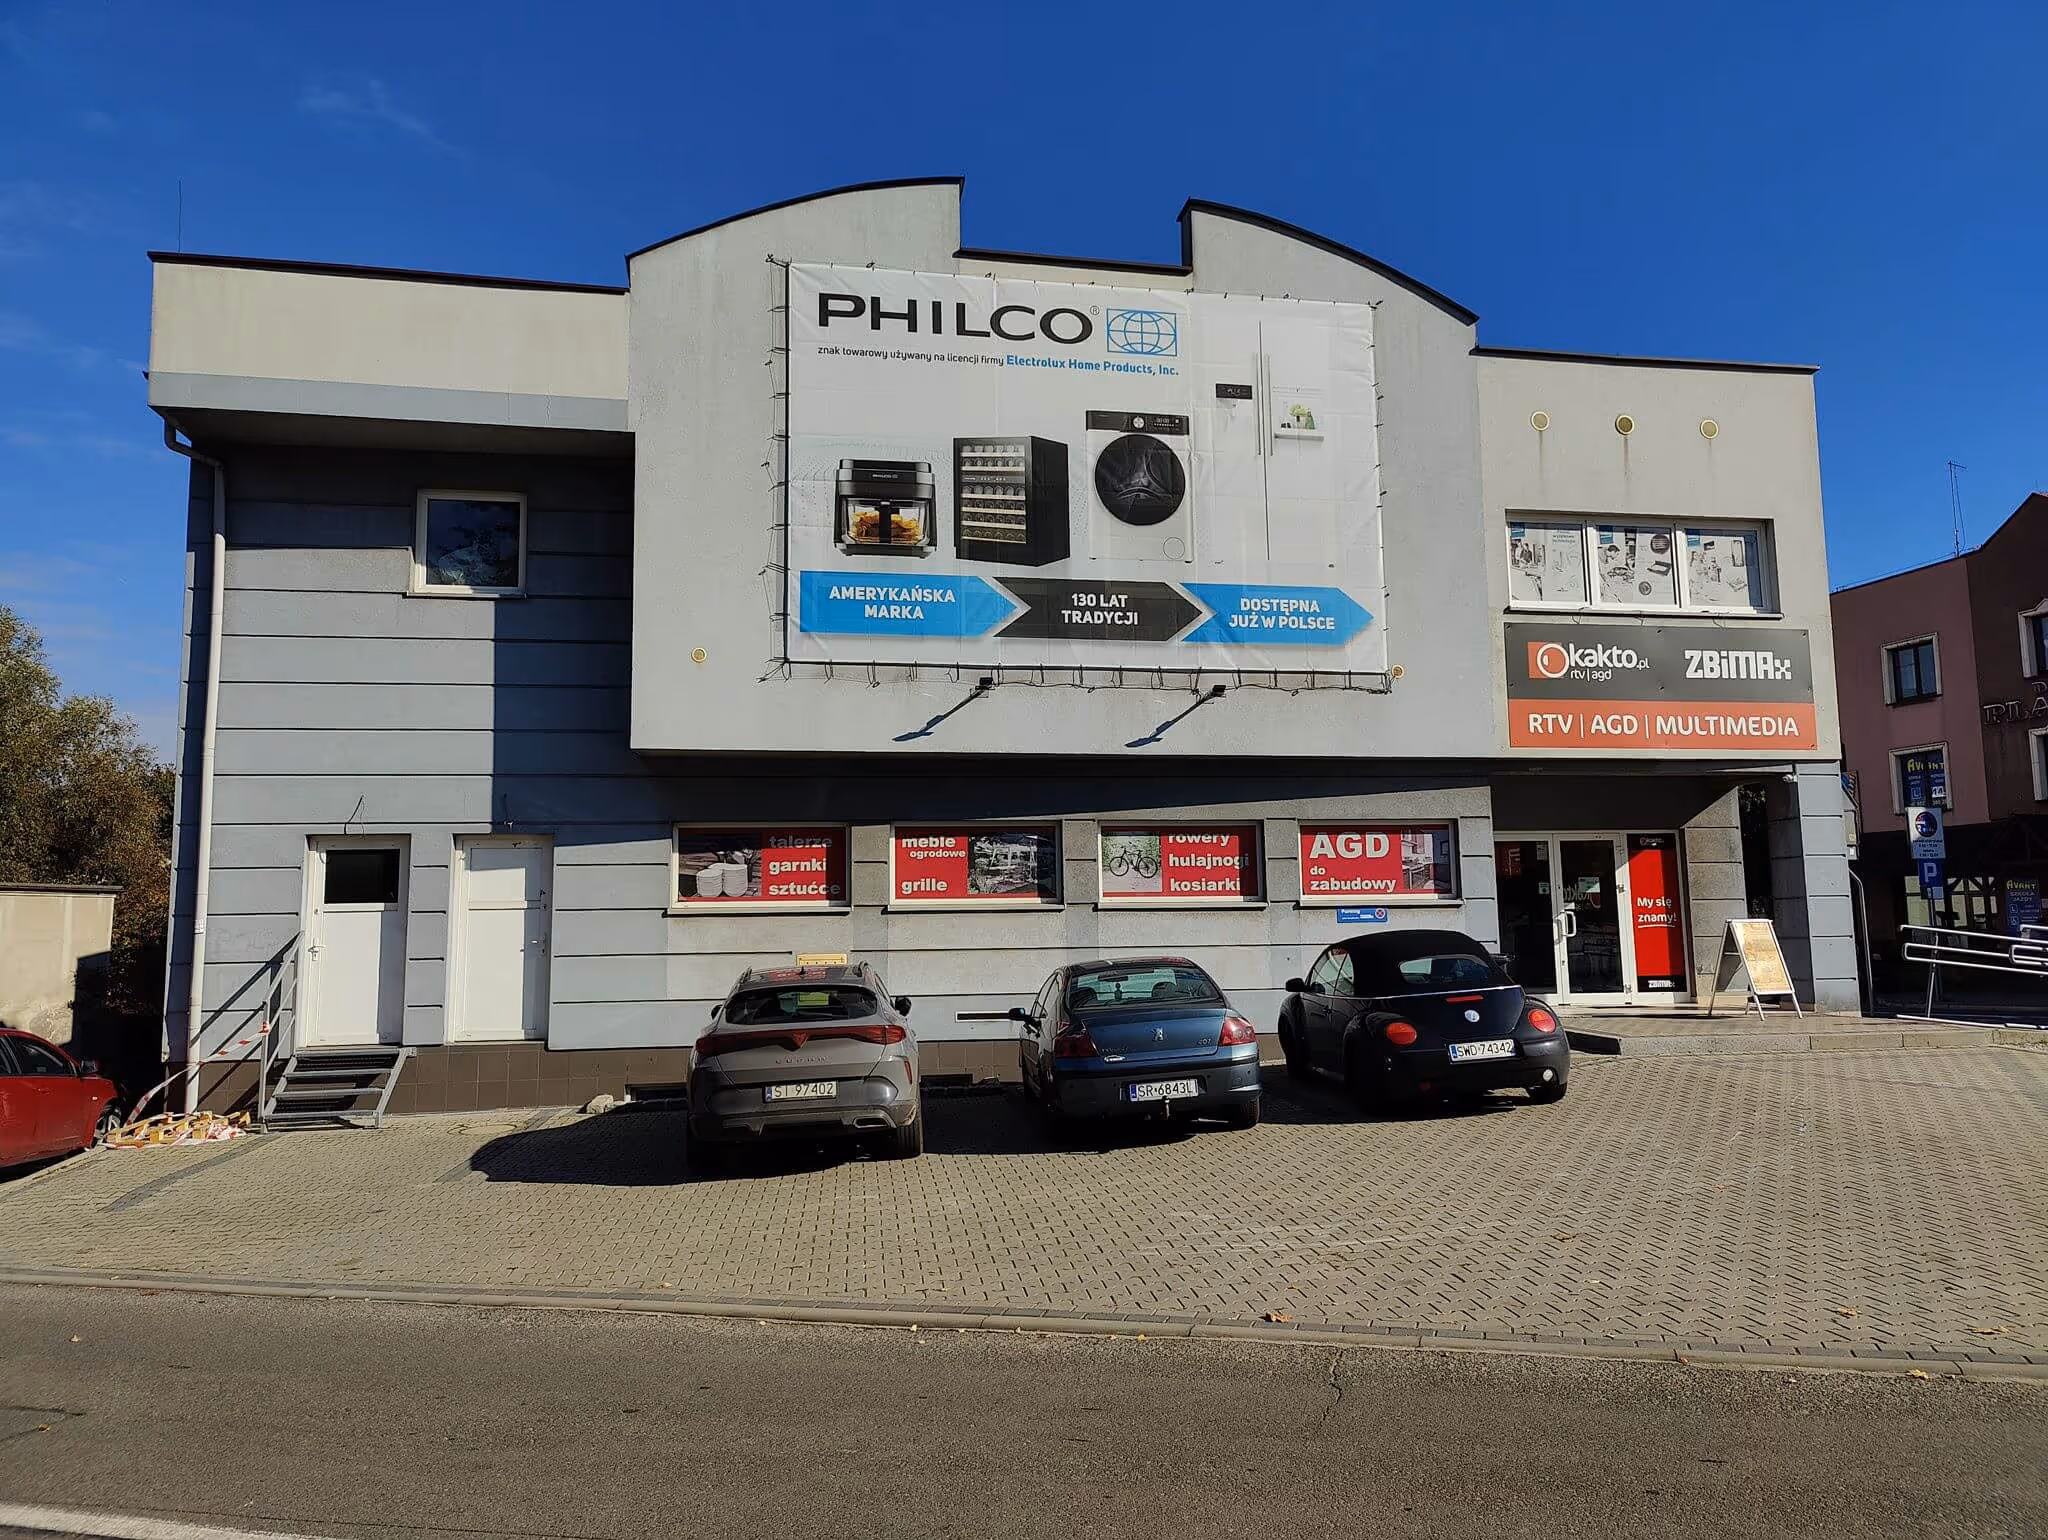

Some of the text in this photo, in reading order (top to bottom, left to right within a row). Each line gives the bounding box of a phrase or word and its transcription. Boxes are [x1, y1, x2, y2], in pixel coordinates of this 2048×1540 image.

[817, 346, 840, 355] znak
[842, 348, 888, 359] towarowy
[890, 350, 932, 362] używany
[947, 353, 979, 364] licencji
[981, 355, 1004, 366] firmy
[1006, 355, 1065, 369] Electrolux
[1068, 359, 1100, 371] Home
[1103, 361, 1155, 376] Products,
[1159, 364, 1179, 376] Inc.
[829, 584, 955, 603] AMERYKAŃSKA
[1071, 593, 1128, 608] 130 LAT
[864, 604, 924, 620] MARKA
[1240, 598, 1320, 616] DOSTĘPNA
[1061, 609, 1139, 626] TRADYCJI
[1229, 612, 1336, 631] JUŻ W POLSCE
[1528, 713, 1800, 738] RTV AGD MULTIMEDIA
[769, 836, 832, 848] talerze
[901, 836, 955, 848] meble
[1168, 833, 1230, 847] rowery
[1309, 832, 1390, 859] AGD
[909, 849, 967, 860] ogrodowe
[1168, 853, 1249, 870] hulajnogi
[769, 858, 827, 875] garnki
[1309, 866, 1326, 875] do
[768, 881, 841, 896] sztućce
[901, 878, 948, 895] grille
[1170, 877, 1240, 892] kosiarki
[1310, 877, 1396, 893] zabudowy
[1637, 896, 1672, 908] My się
[1638, 912, 1677, 923] znamy!
[1457, 1042, 1513, 1057] SWD 74342
[795, 1083, 834, 1096] 97402
[1138, 1083, 1193, 1098] SR 6843L
